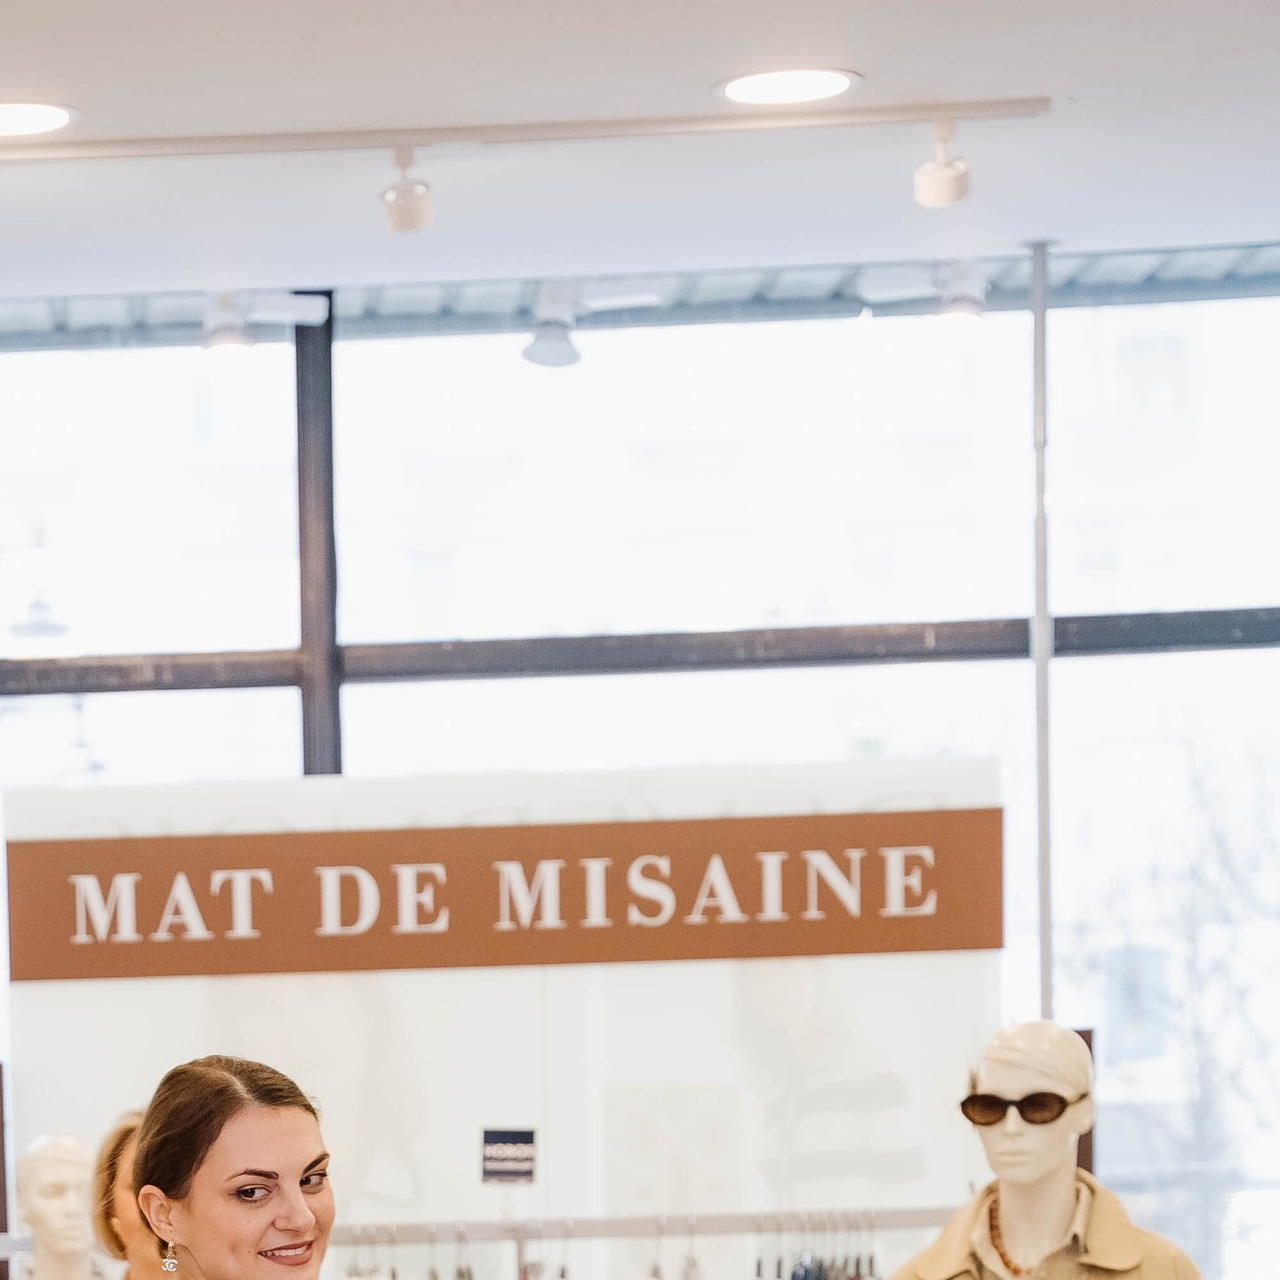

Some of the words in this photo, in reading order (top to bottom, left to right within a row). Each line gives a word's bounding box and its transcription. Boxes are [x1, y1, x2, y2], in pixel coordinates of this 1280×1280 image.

[68, 866, 275, 946] MAT
[314, 861, 451, 937] DE
[492, 844, 939, 932] MISAINE
